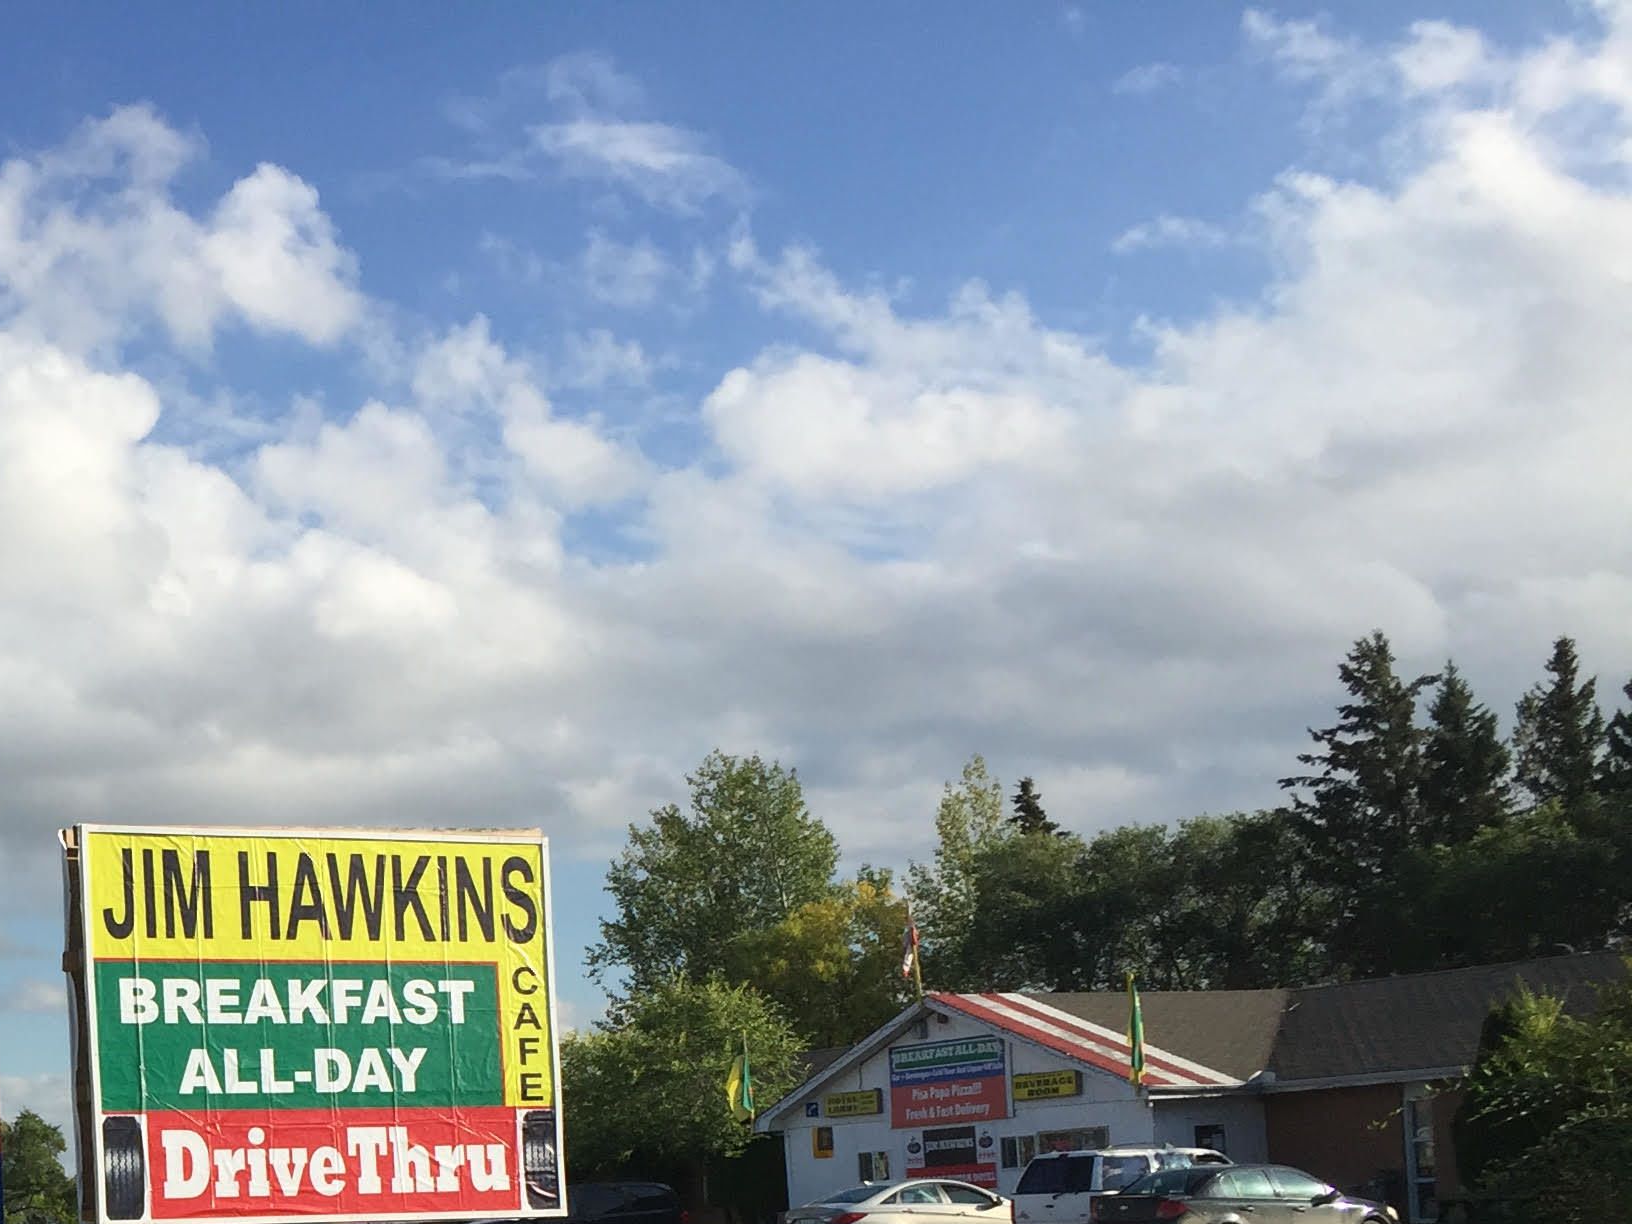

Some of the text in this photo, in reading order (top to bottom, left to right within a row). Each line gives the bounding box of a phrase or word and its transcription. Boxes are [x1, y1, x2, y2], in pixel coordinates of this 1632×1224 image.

[103, 848, 538, 944] JIM HAWKINS
[118, 978, 476, 1025] BREAKFAST
[511, 966, 545, 1102] CAFE
[178, 1047, 428, 1094] ALL-DAY
